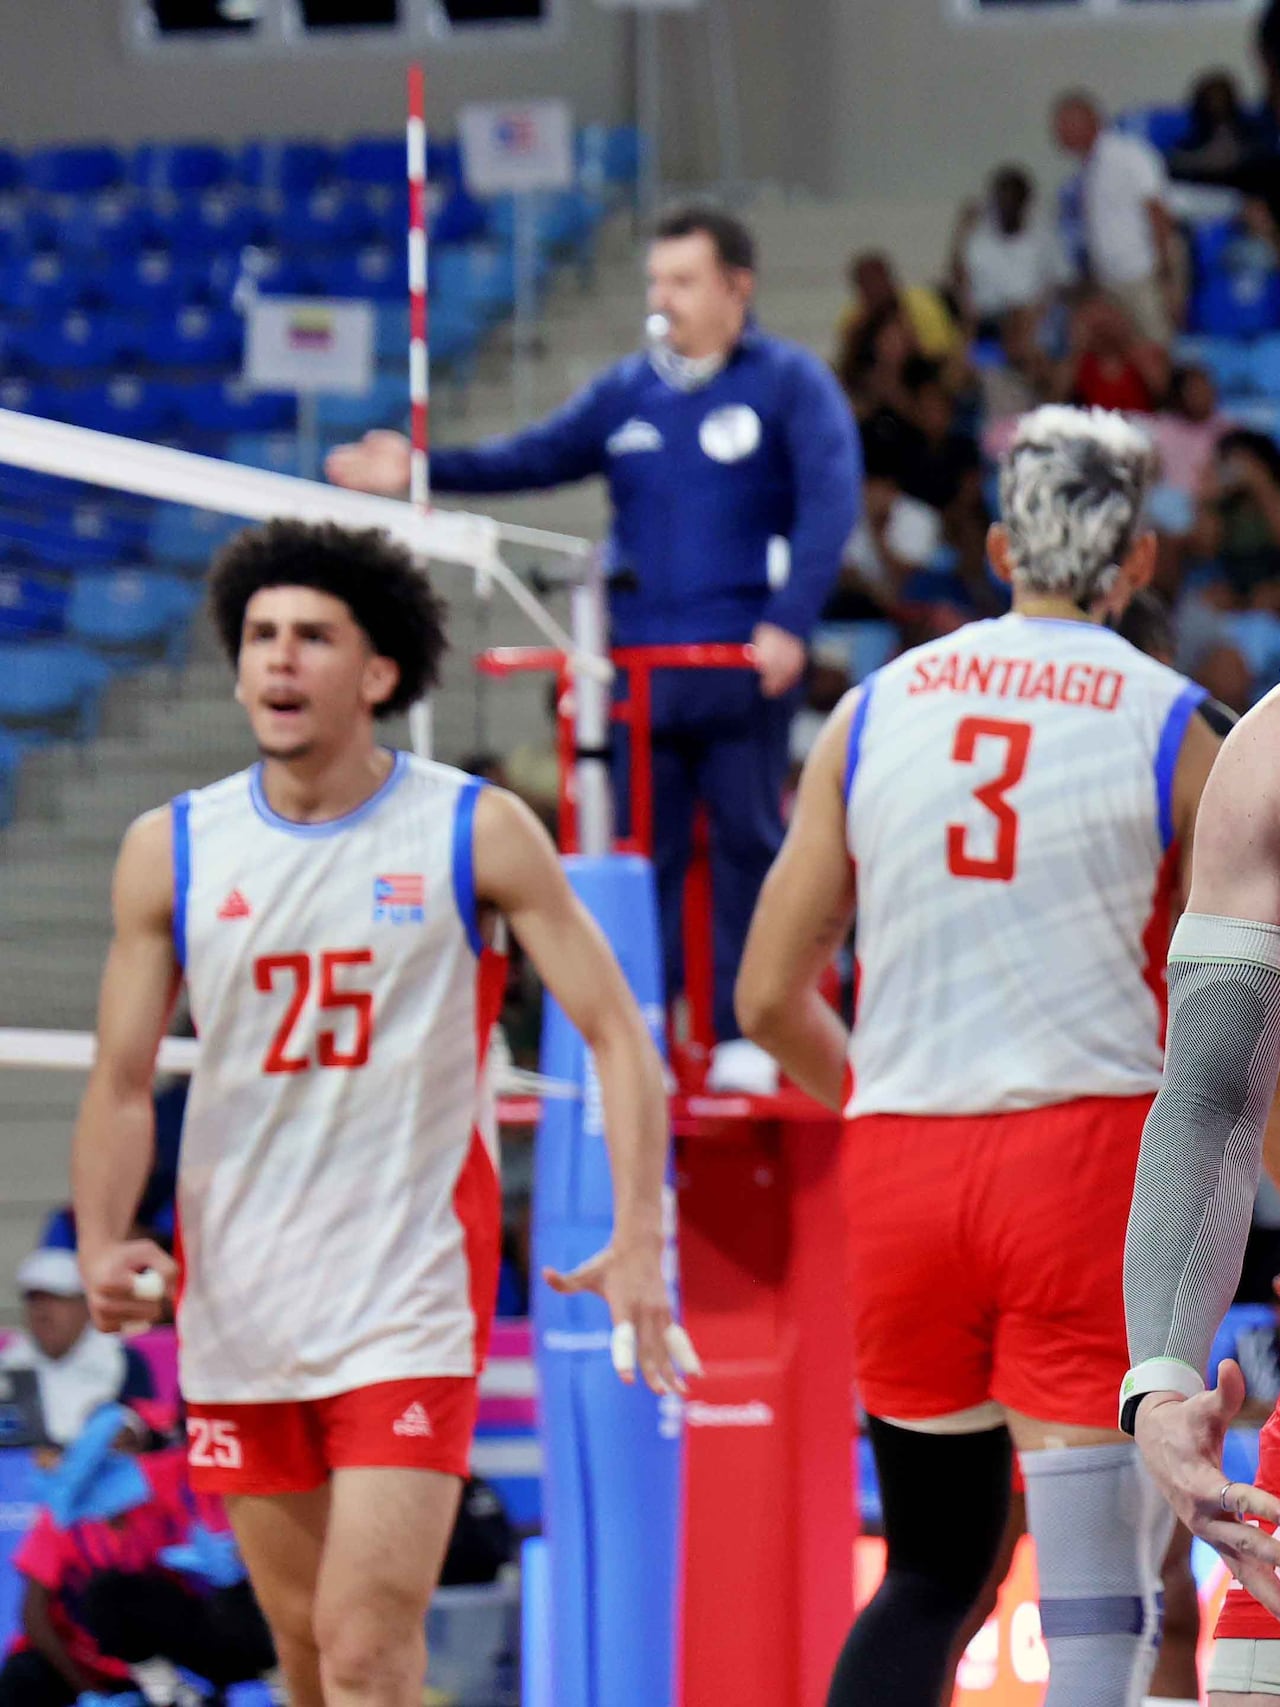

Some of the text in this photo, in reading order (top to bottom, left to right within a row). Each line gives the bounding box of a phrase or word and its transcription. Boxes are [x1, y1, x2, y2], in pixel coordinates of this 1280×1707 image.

[908, 653, 1124, 711] SANTIAGO
[946, 714, 1033, 882] 3
[254, 947, 374, 1075] 25
[185, 1416, 243, 1470] 25
